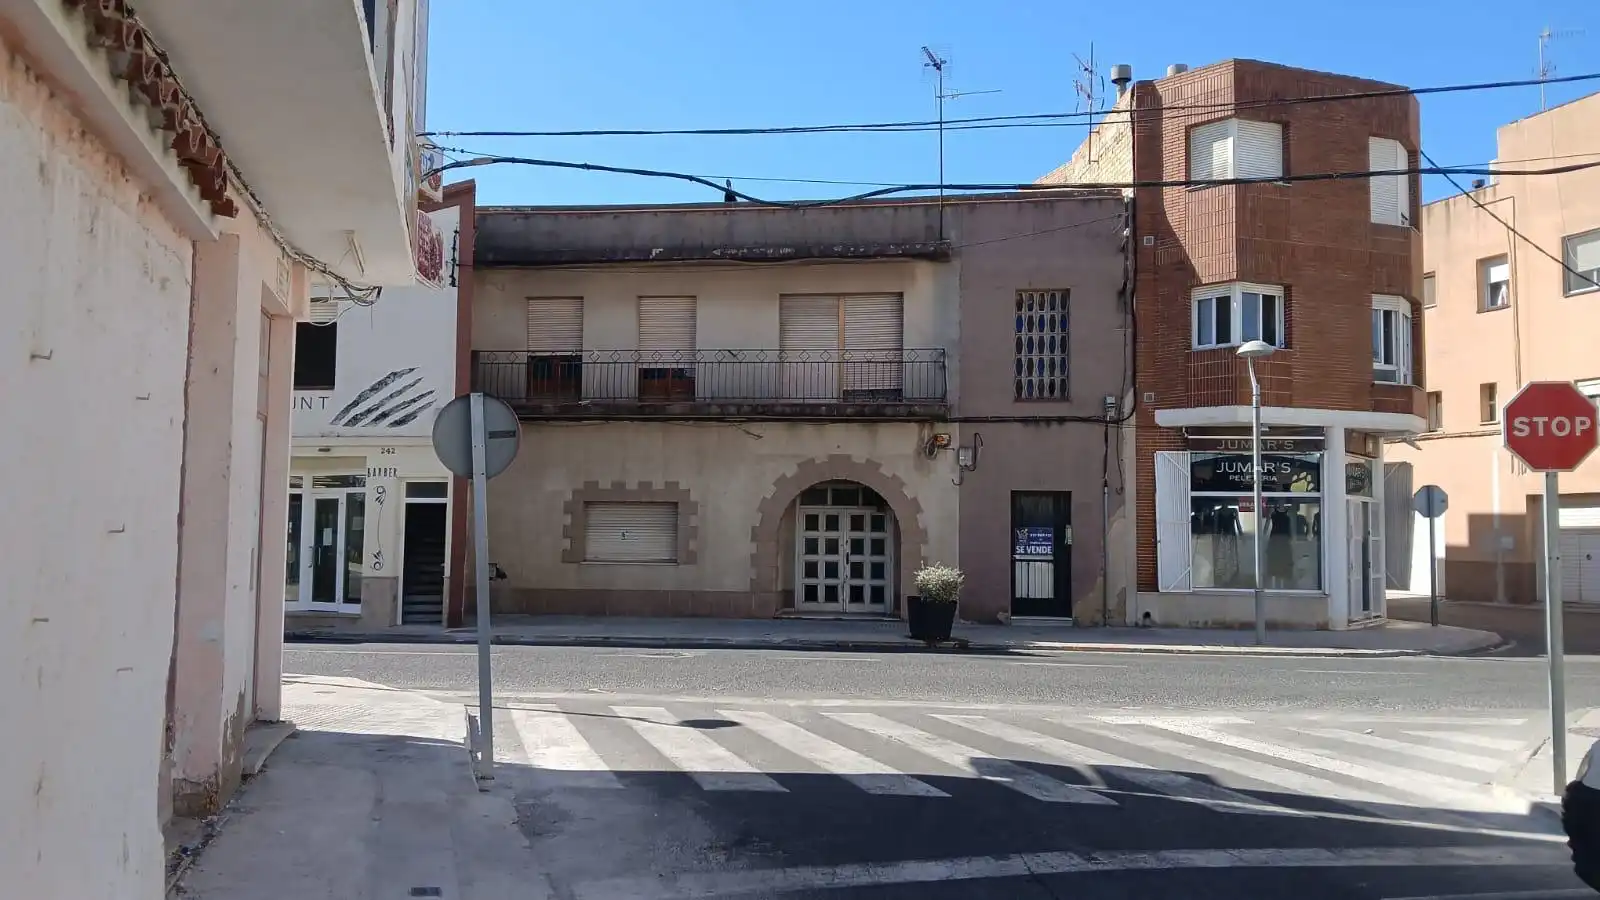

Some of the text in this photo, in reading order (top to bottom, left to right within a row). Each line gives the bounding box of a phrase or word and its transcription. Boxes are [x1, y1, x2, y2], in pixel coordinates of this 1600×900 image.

[1512, 416, 1591, 437] STOP
[367, 467, 398, 478] BARBER
[1016, 545, 1053, 554] SE VENDE
